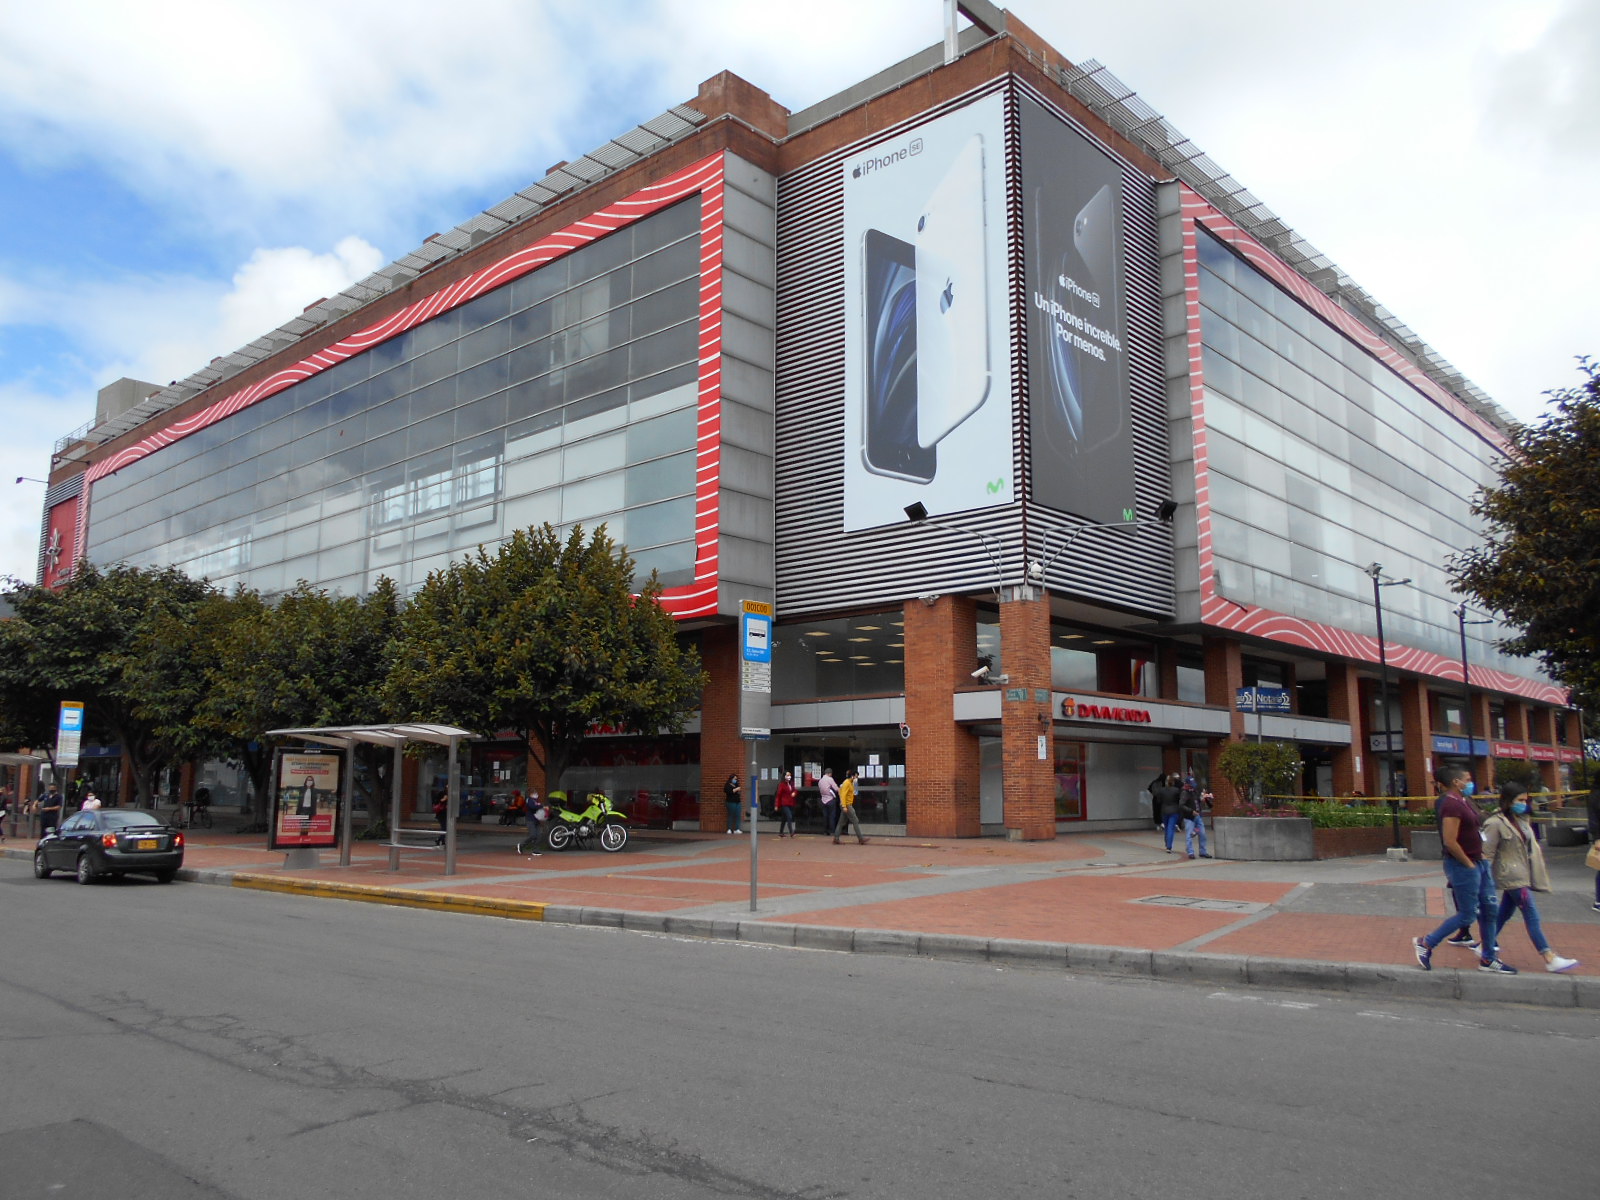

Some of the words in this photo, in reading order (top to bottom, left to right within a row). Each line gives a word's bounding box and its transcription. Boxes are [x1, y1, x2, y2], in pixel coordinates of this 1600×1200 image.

[862, 148, 907, 176] iPhone
[1065, 276, 1092, 303] iPhone
[1034, 291, 1050, 313] Un
[1050, 299, 1084, 331] iPhone
[1056, 322, 1074, 344] Por
[1073, 334, 1107, 361] menos.
